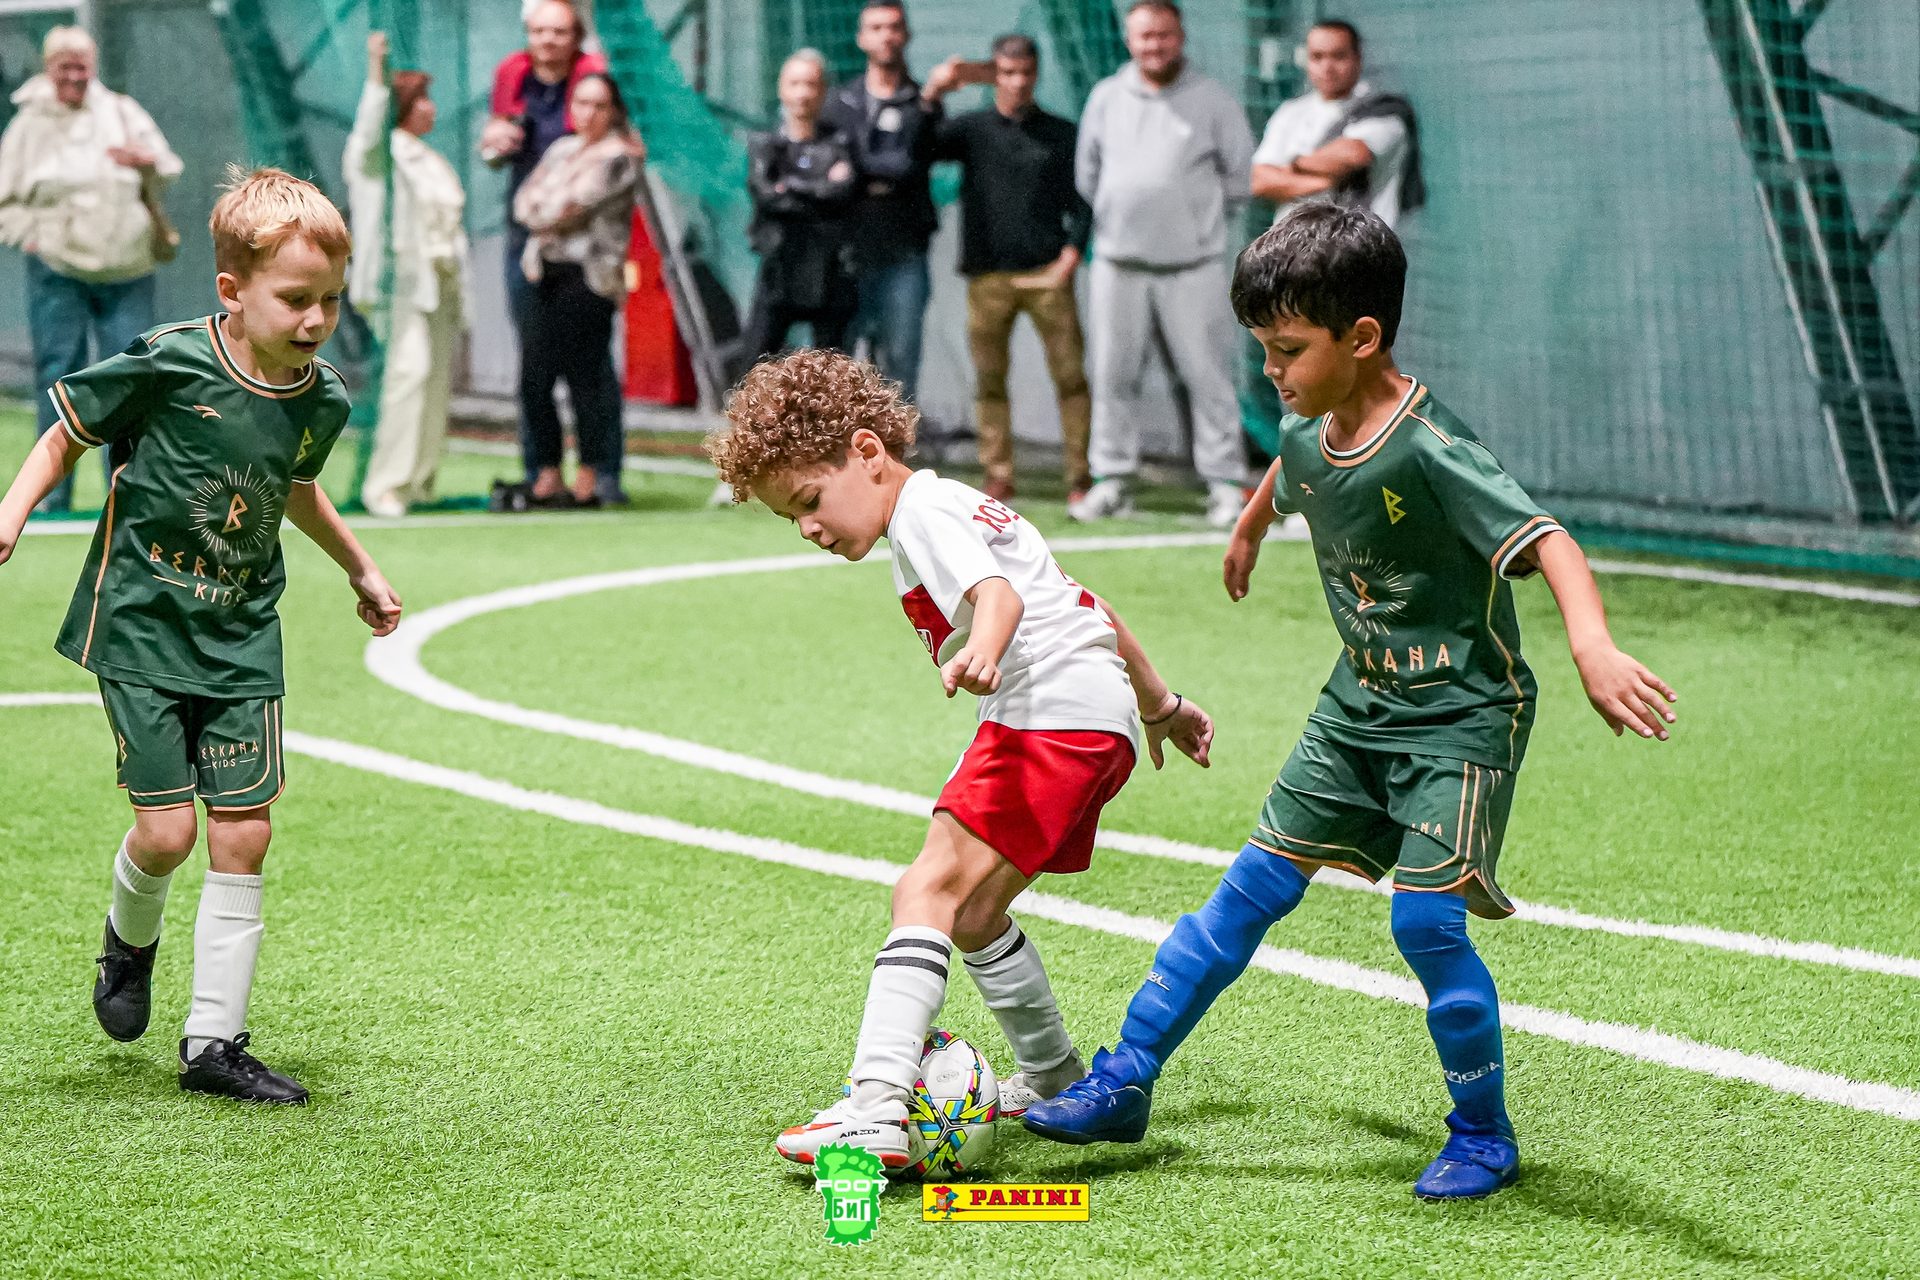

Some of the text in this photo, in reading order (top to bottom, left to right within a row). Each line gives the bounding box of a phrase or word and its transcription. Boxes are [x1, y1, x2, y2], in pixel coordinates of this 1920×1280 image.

[211, 758, 236, 770] KIDS
[839, 1128, 880, 1139] AIR ZOOM
